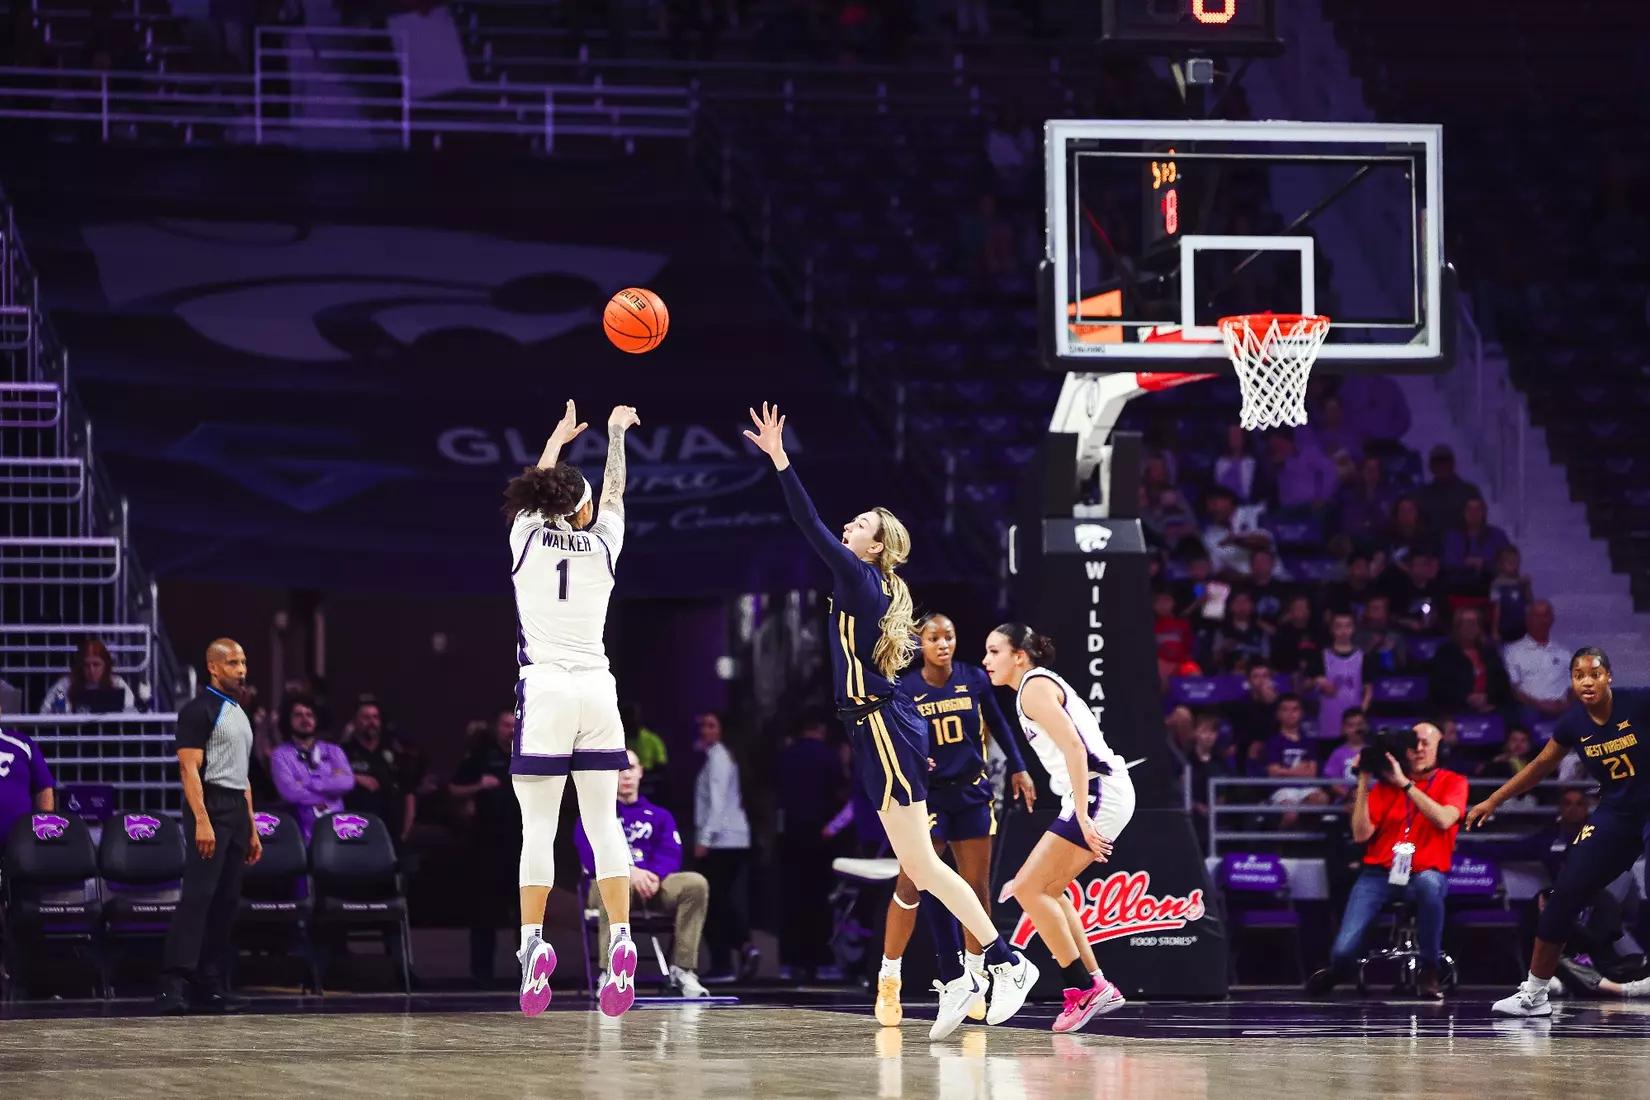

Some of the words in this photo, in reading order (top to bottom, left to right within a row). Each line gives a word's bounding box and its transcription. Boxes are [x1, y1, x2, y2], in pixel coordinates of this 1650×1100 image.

[542, 530, 591, 552] WALKER
[555, 558, 570, 602] 1
[1084, 561, 1107, 736] WILDCAT
[931, 715, 964, 746] 10
[1584, 743, 1603, 758] WEST
[1602, 733, 1638, 754] VIRGINIA
[1602, 753, 1636, 779] 21
[1130, 936, 1158, 947] FOOD
